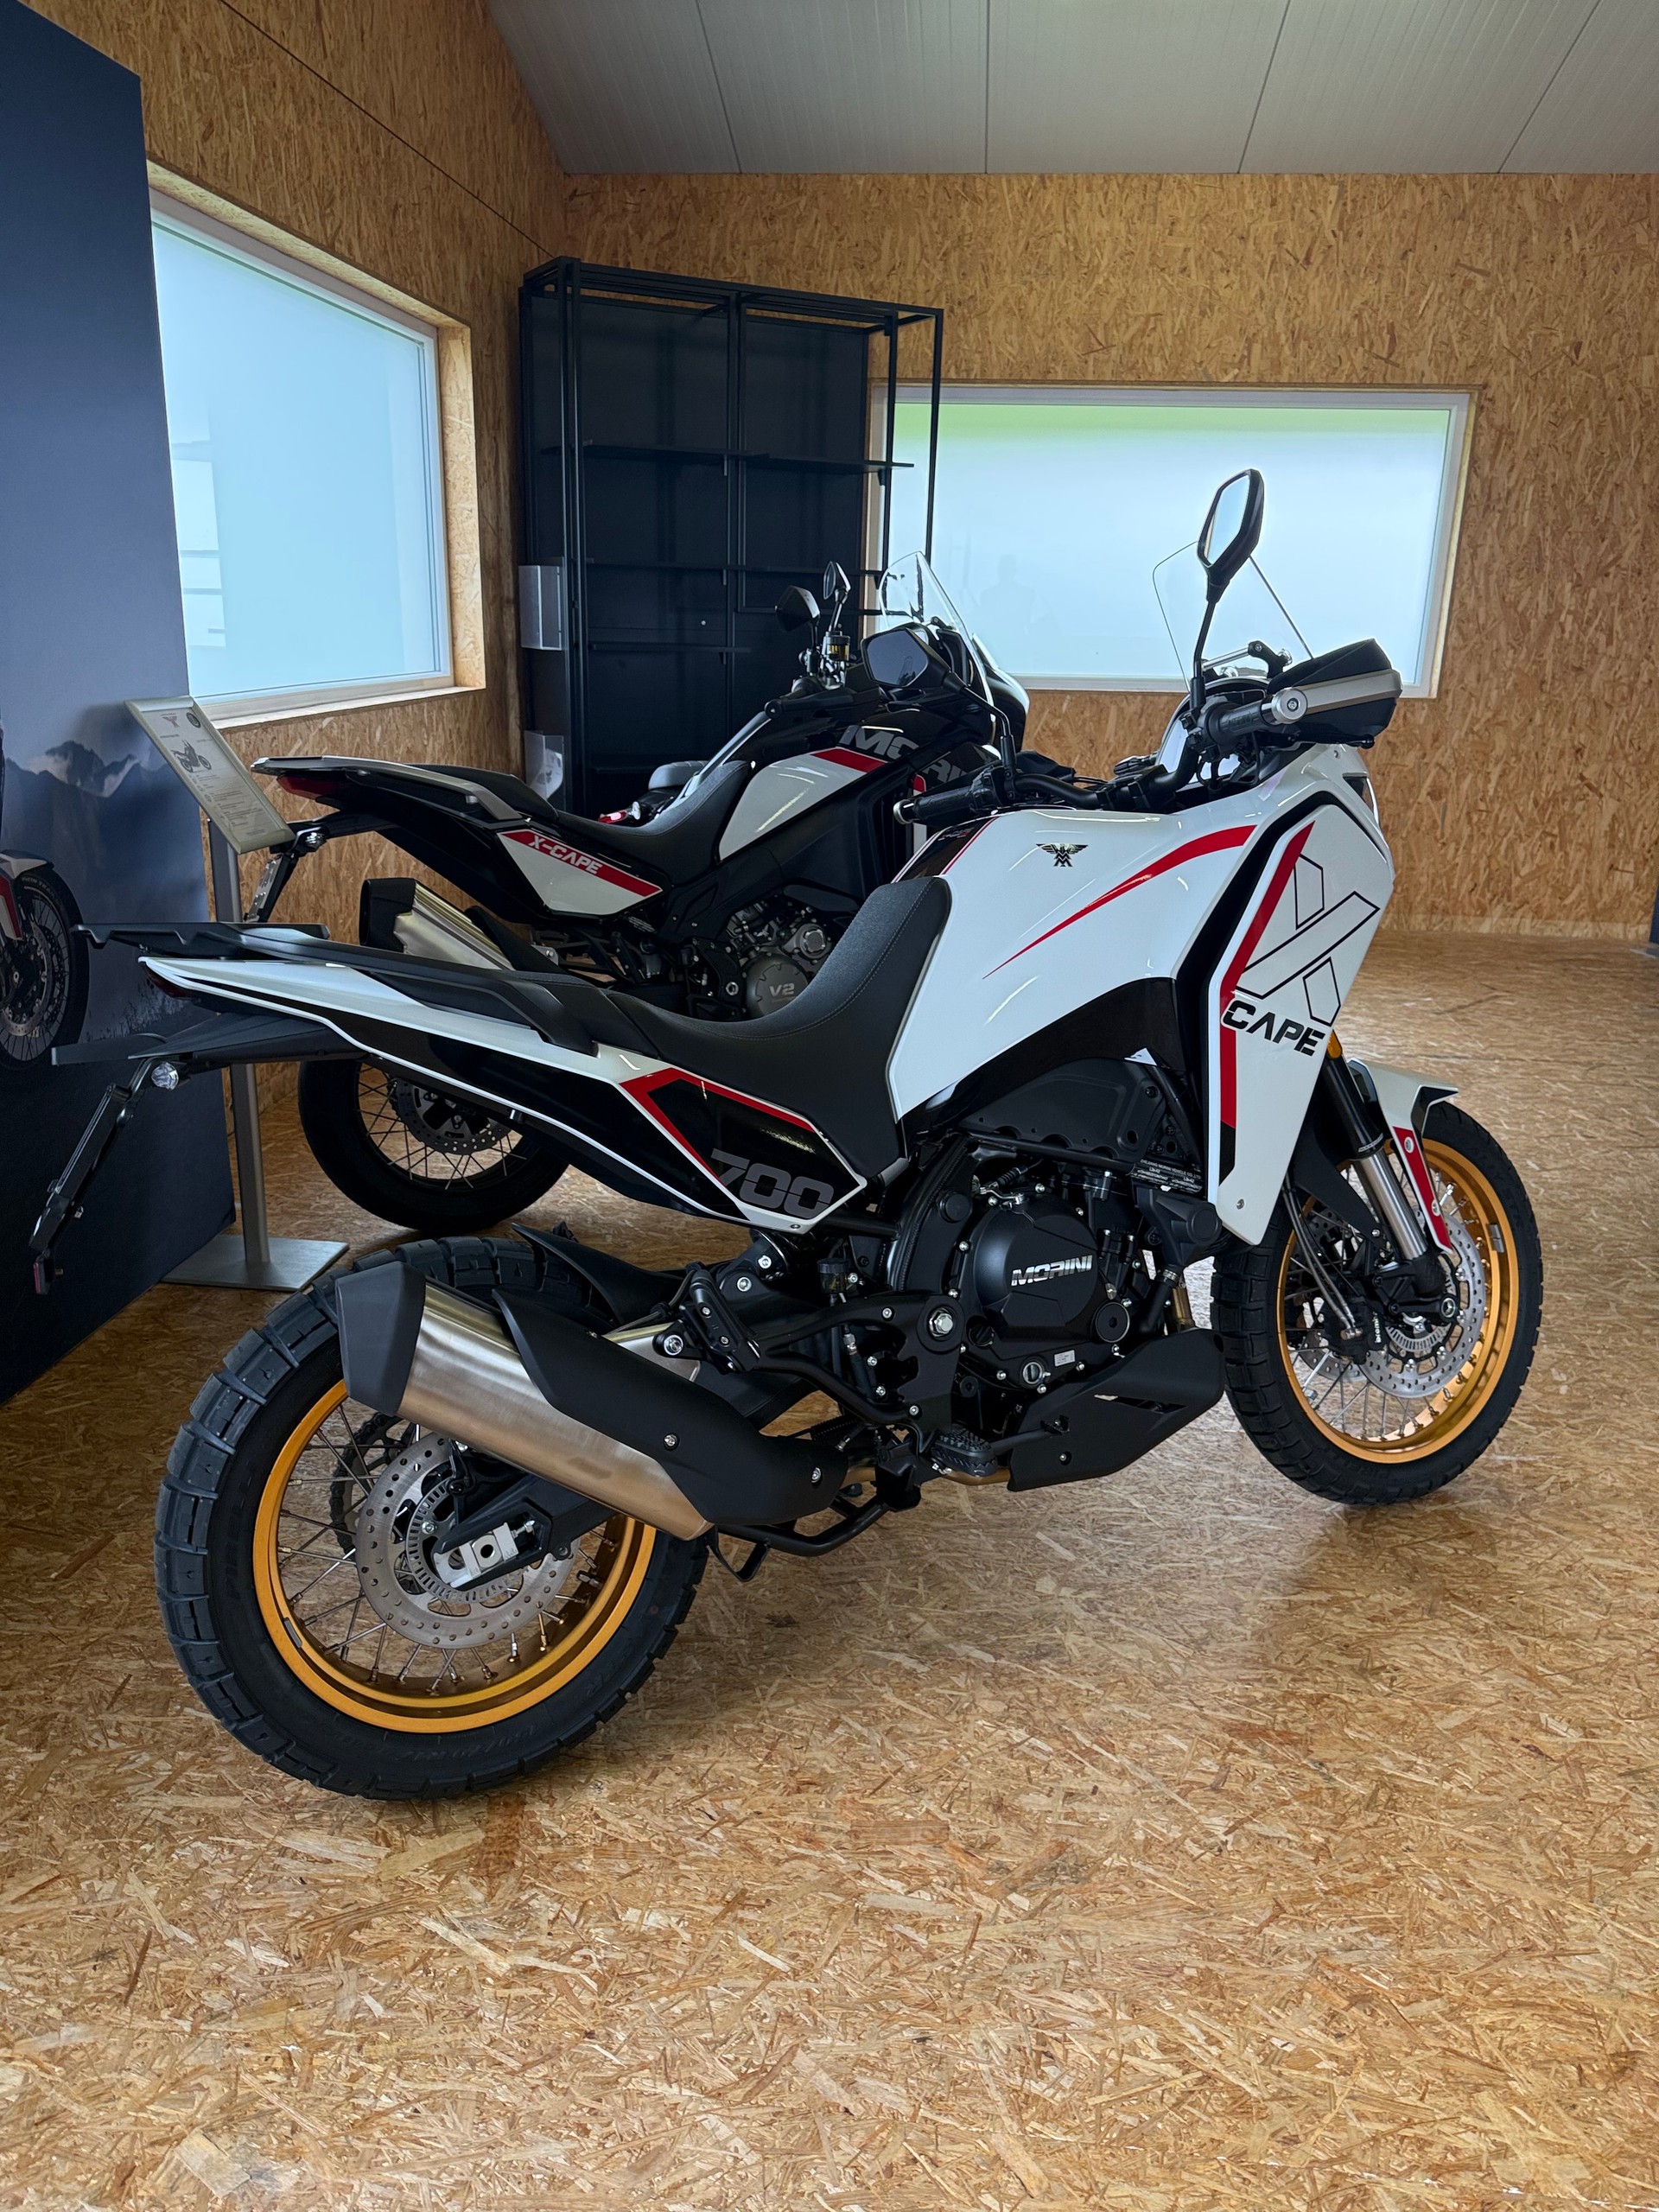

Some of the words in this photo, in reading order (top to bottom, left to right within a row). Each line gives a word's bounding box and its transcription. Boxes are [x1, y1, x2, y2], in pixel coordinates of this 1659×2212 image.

[528, 835, 603, 874] X-CAPE
[769, 982, 795, 997] V2
[1223, 1000, 1334, 1056] CAPE
[710, 1148, 834, 1219] 700
[1011, 1255, 1093, 1287] MORINI
